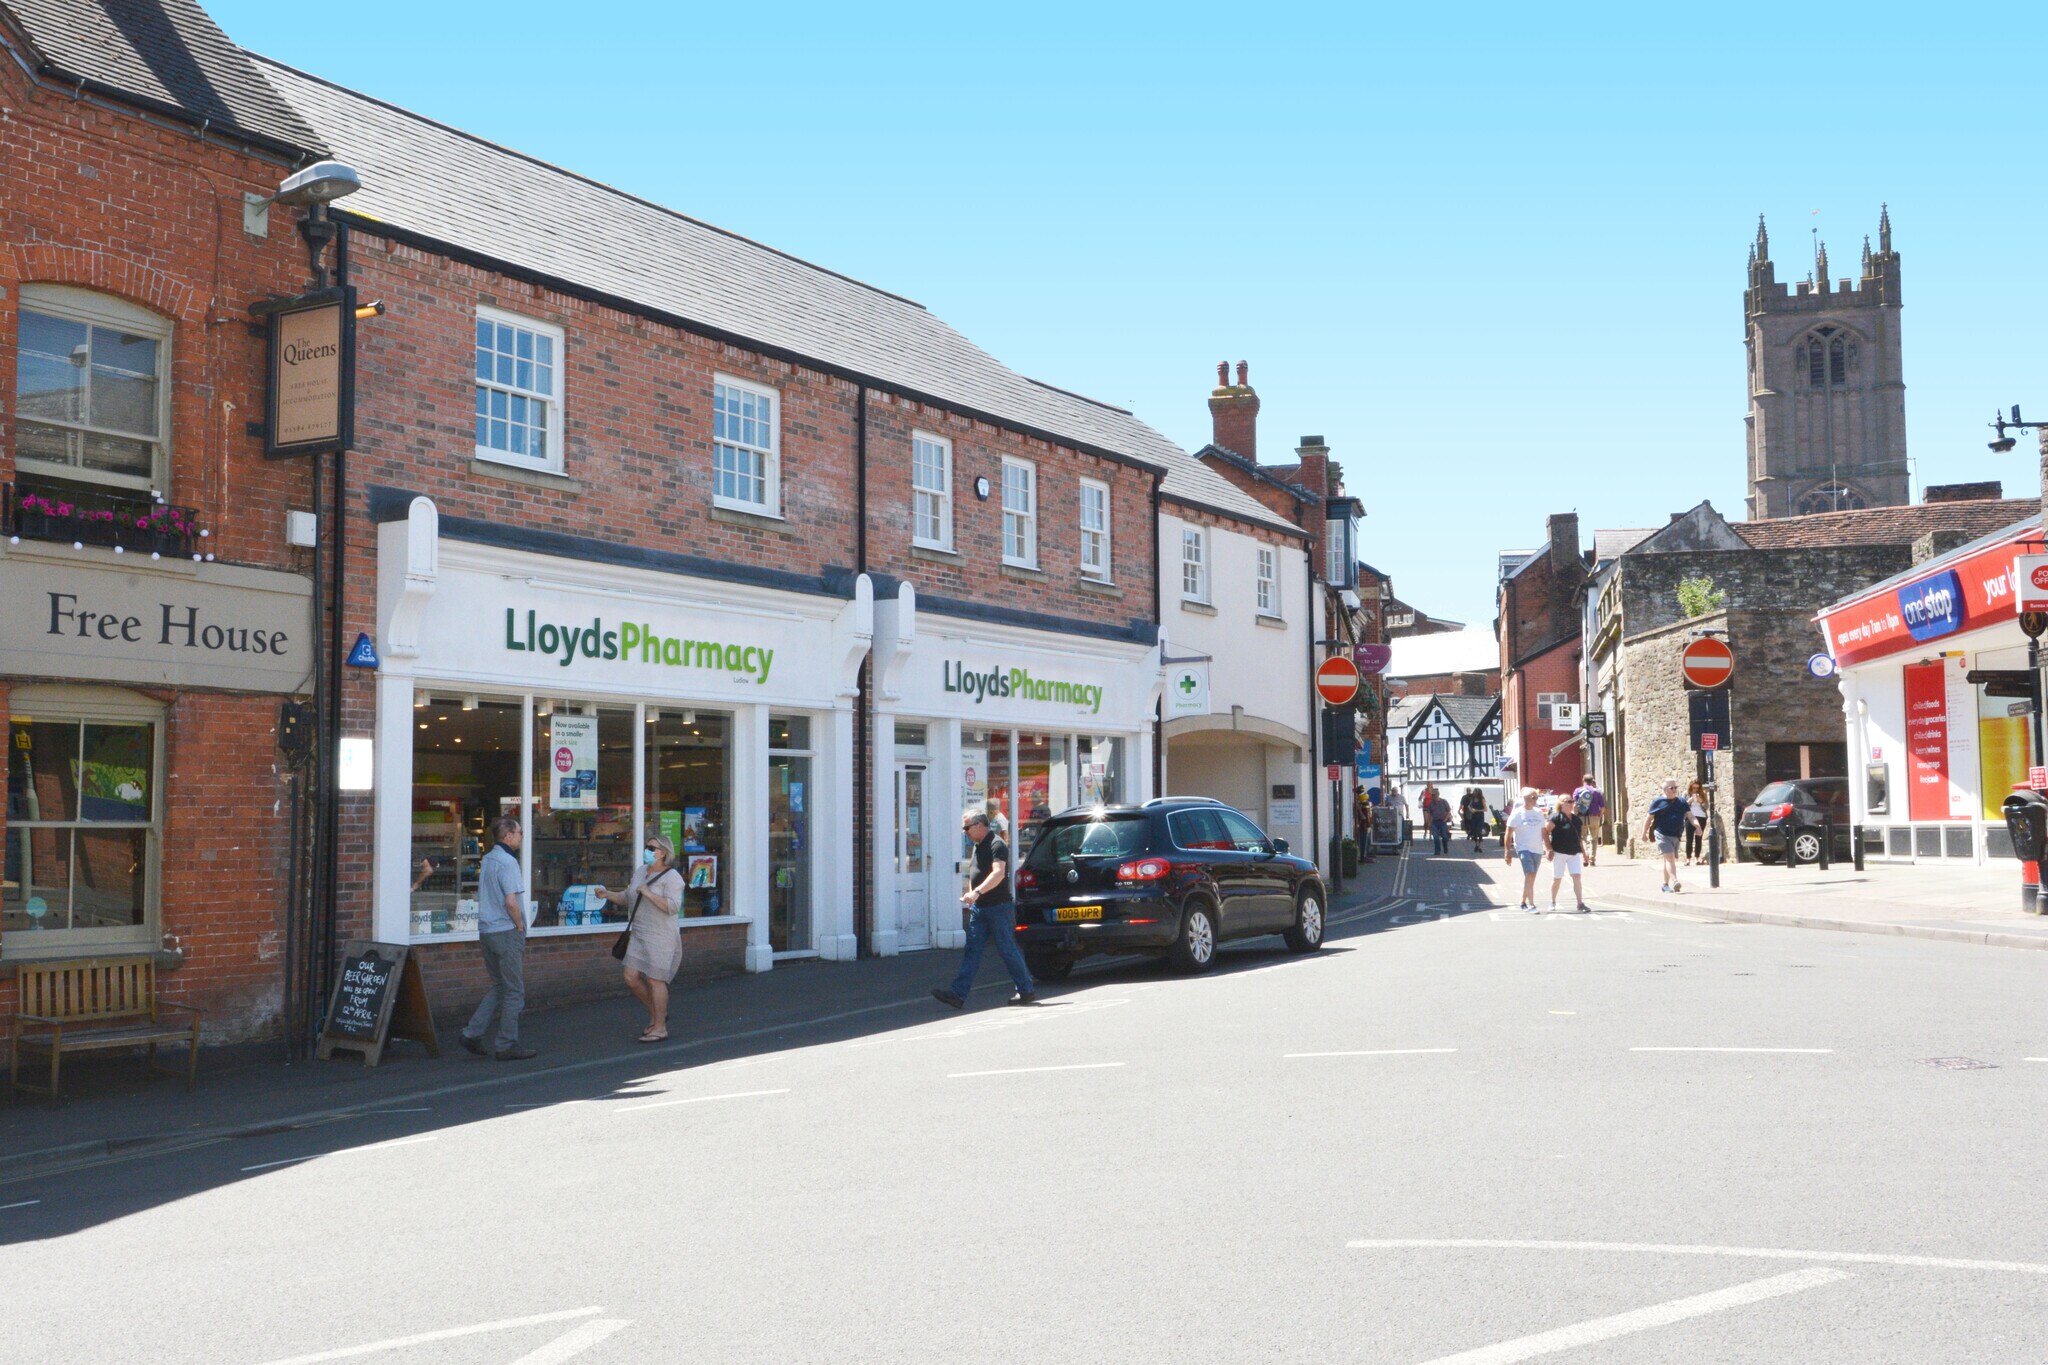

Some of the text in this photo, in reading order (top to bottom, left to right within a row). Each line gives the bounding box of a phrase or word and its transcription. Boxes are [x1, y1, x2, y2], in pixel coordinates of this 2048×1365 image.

[296, 337, 310, 348] The
[284, 343, 337, 366] Queens
[1983, 575, 2007, 606] your
[1905, 586, 1953, 625] one stop
[46, 591, 289, 656] Free House
[1838, 631, 1851, 648] open
[1848, 627, 1862, 641] every
[1861, 621, 1871, 639] day
[1880, 619, 1888, 631] to
[506, 607, 774, 685] LloydsPharmacy
[944, 659, 1103, 715] LloydsPharmacy
[1926, 700, 1940, 709] foods
[568, 721, 590, 729] available
[1925, 714, 1946, 725] groceries
[1927, 729, 1941, 739] drinks
[557, 900, 574, 911] NHS
[1080, 906, 1099, 918] UPR
[359, 961, 376, 973] OUR
[344, 969, 388, 986] BEER GARDEN
[354, 986, 362, 995] BE
[362, 986, 378, 996] OPEN
[350, 994, 368, 1008] FROM
[353, 1008, 372, 1020] APRIL
